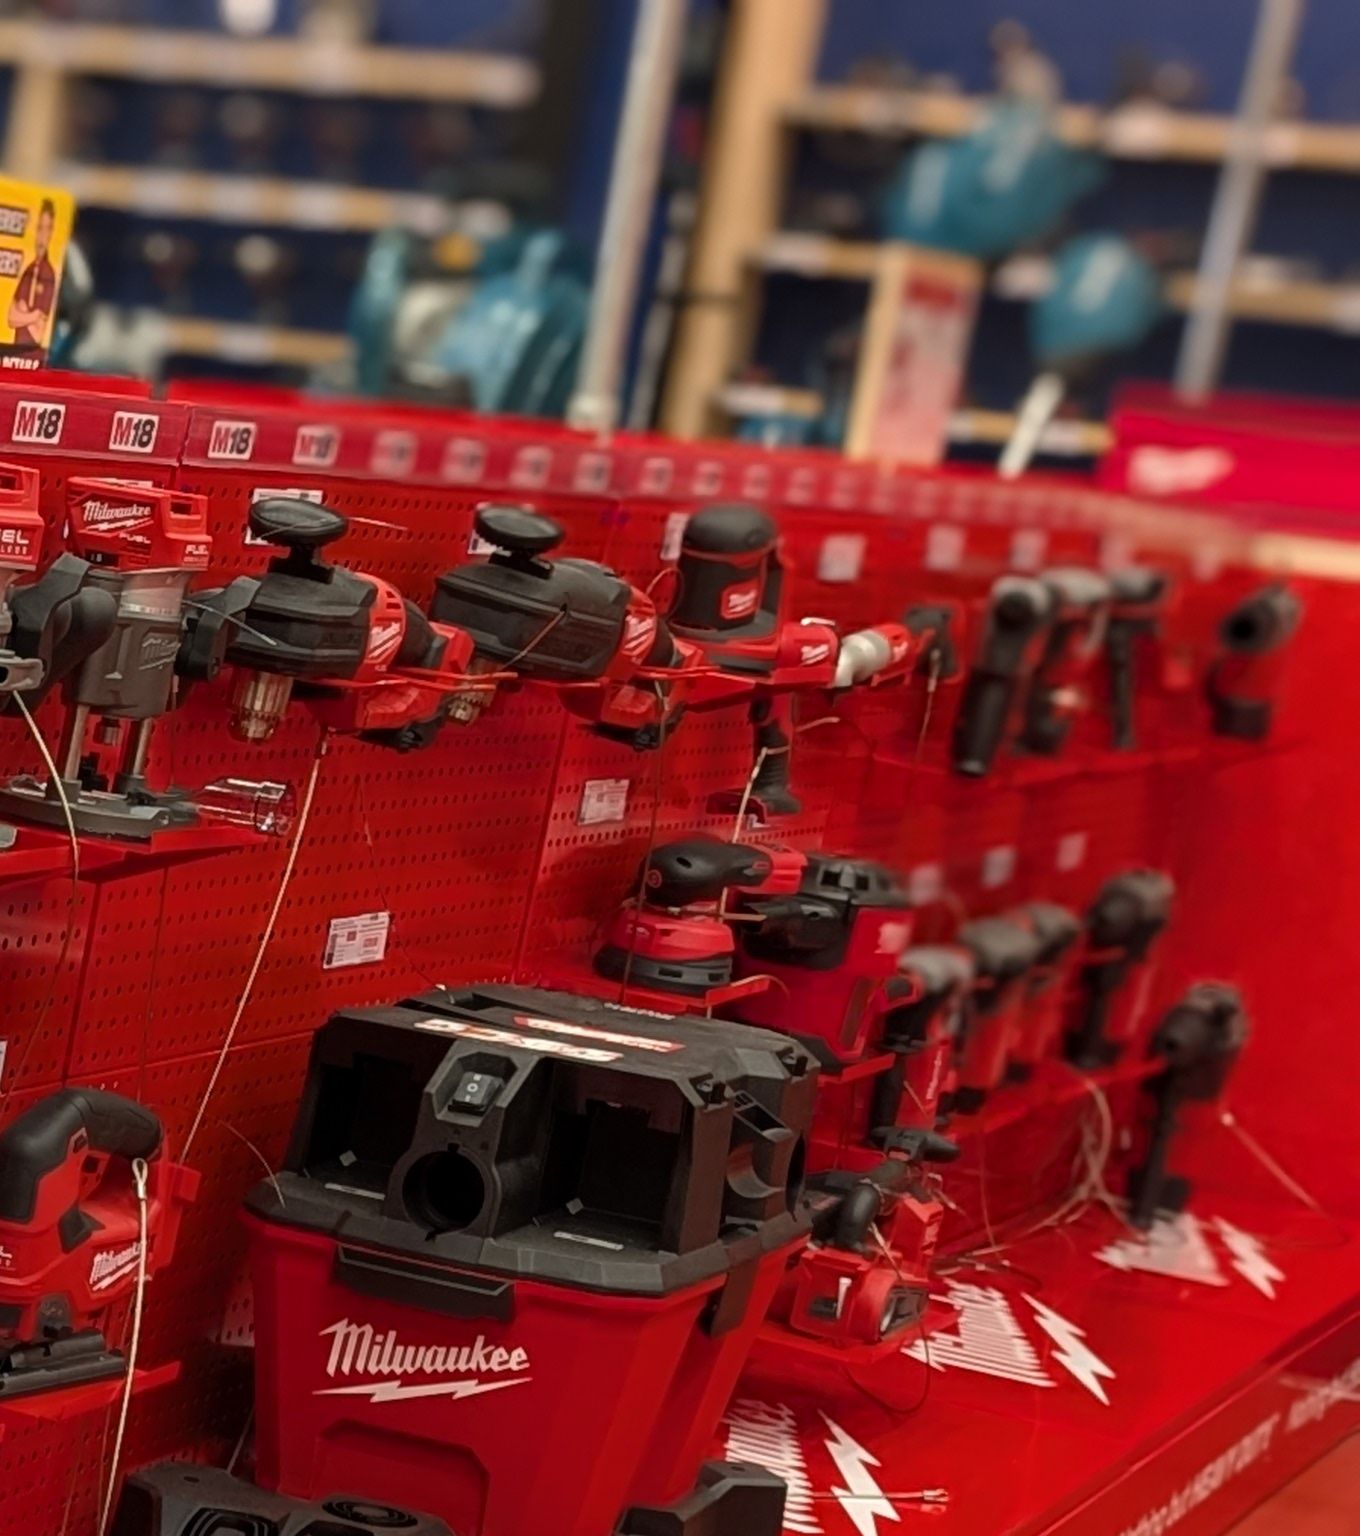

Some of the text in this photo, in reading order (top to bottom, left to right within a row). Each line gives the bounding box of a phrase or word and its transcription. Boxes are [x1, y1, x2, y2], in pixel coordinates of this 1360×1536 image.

[17, 408, 61, 440] M18
[113, 417, 155, 447] M18
[214, 425, 251, 456] M18
[82, 500, 151, 523] Milwaukee
[119, 532, 151, 544] FUEL
[319, 1318, 531, 1378] Milwaukee
